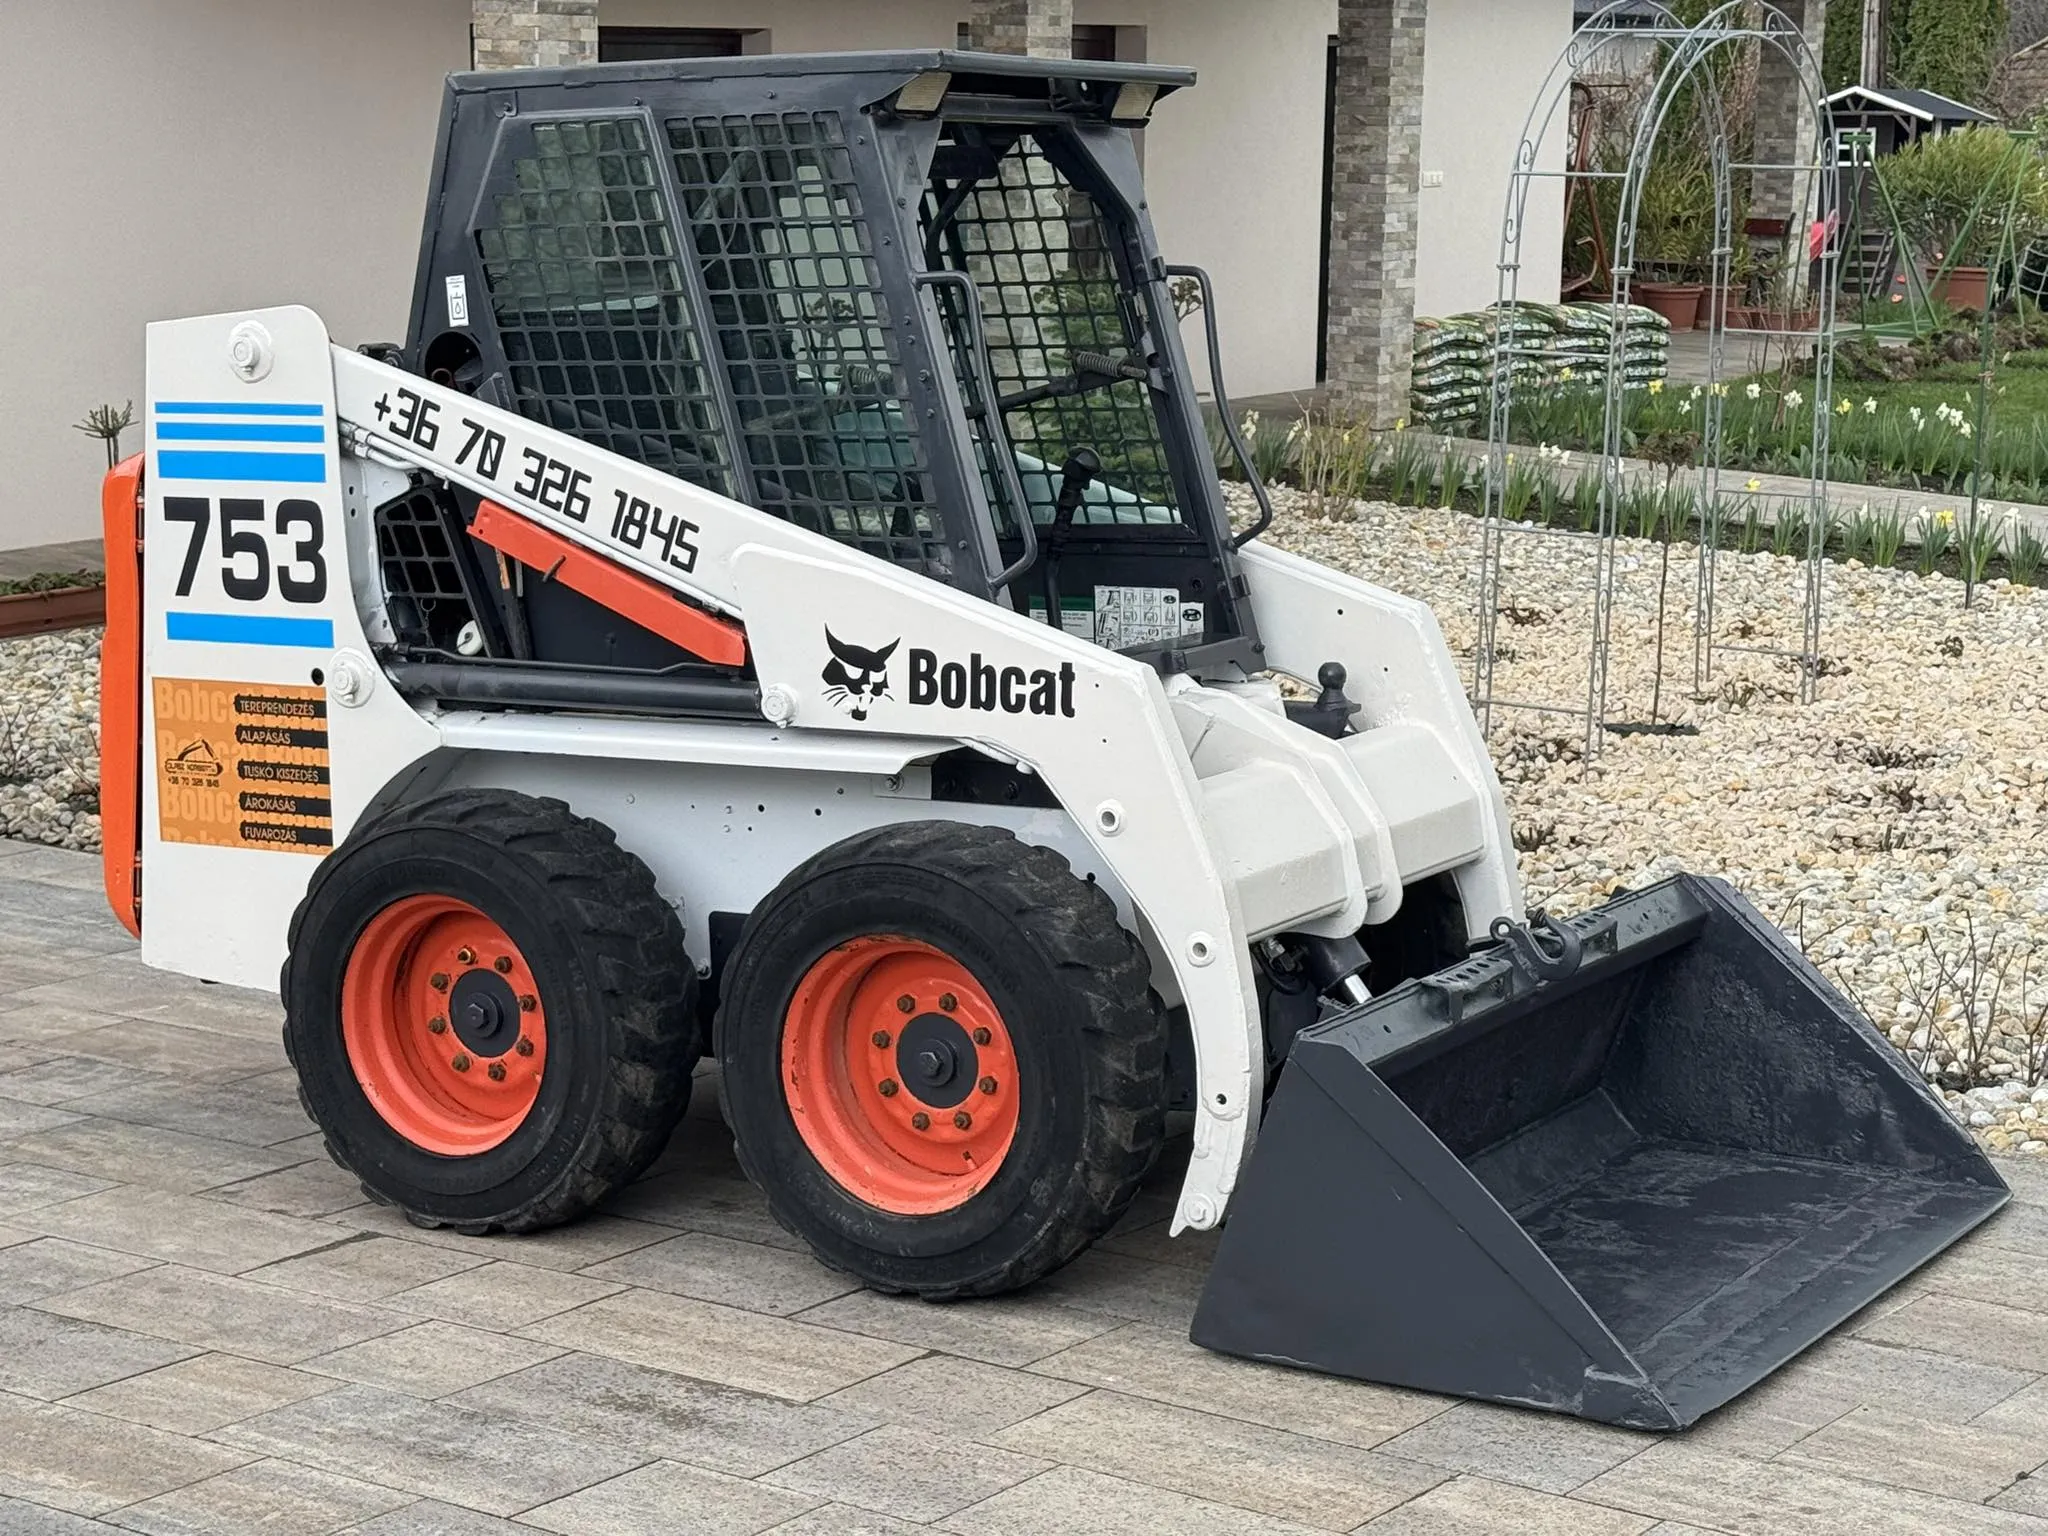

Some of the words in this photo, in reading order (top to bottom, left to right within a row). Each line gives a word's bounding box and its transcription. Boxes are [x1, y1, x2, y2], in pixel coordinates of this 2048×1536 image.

[374, 387, 441, 451] +36
[455, 417, 506, 481] 70
[514, 447, 592, 524] 326
[611, 488, 700, 575] 1845
[163, 496, 328, 604] 753
[909, 648, 1075, 718] Bobcat
[240, 700, 315, 716] TEREPRENDEZÉS
[240, 729, 291, 745] ALAPÁSÁS
[243, 764, 274, 779] TUSKÓ
[276, 767, 319, 783] KISZEDÉS
[244, 794, 297, 813] ÁROKÁSÁS
[244, 826, 297, 842] FUVAROZÁS
